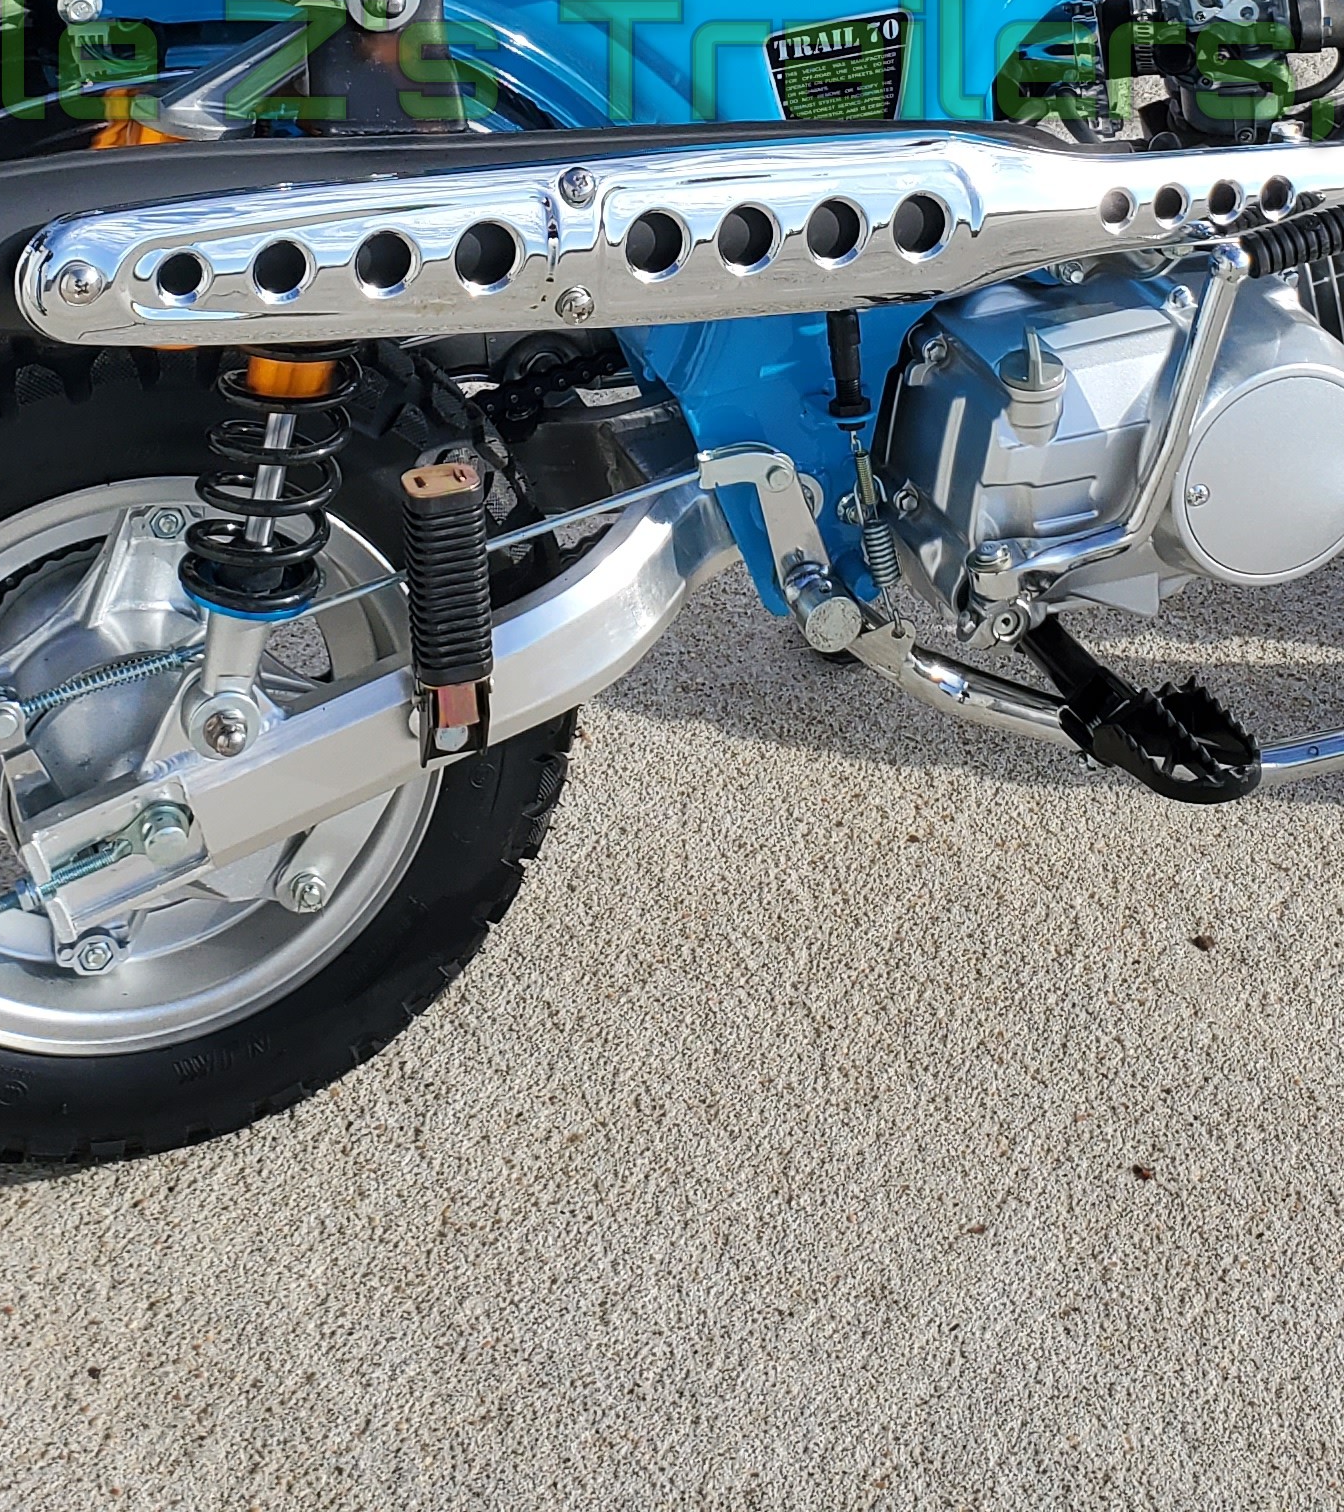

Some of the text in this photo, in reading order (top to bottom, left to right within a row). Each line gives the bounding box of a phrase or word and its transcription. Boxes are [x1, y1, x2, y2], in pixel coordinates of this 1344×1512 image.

[773, 18, 900, 62] TRAIL 70
[802, 66, 826, 74] VEHICLE
[851, 52, 896, 64] MANUFACTURED
